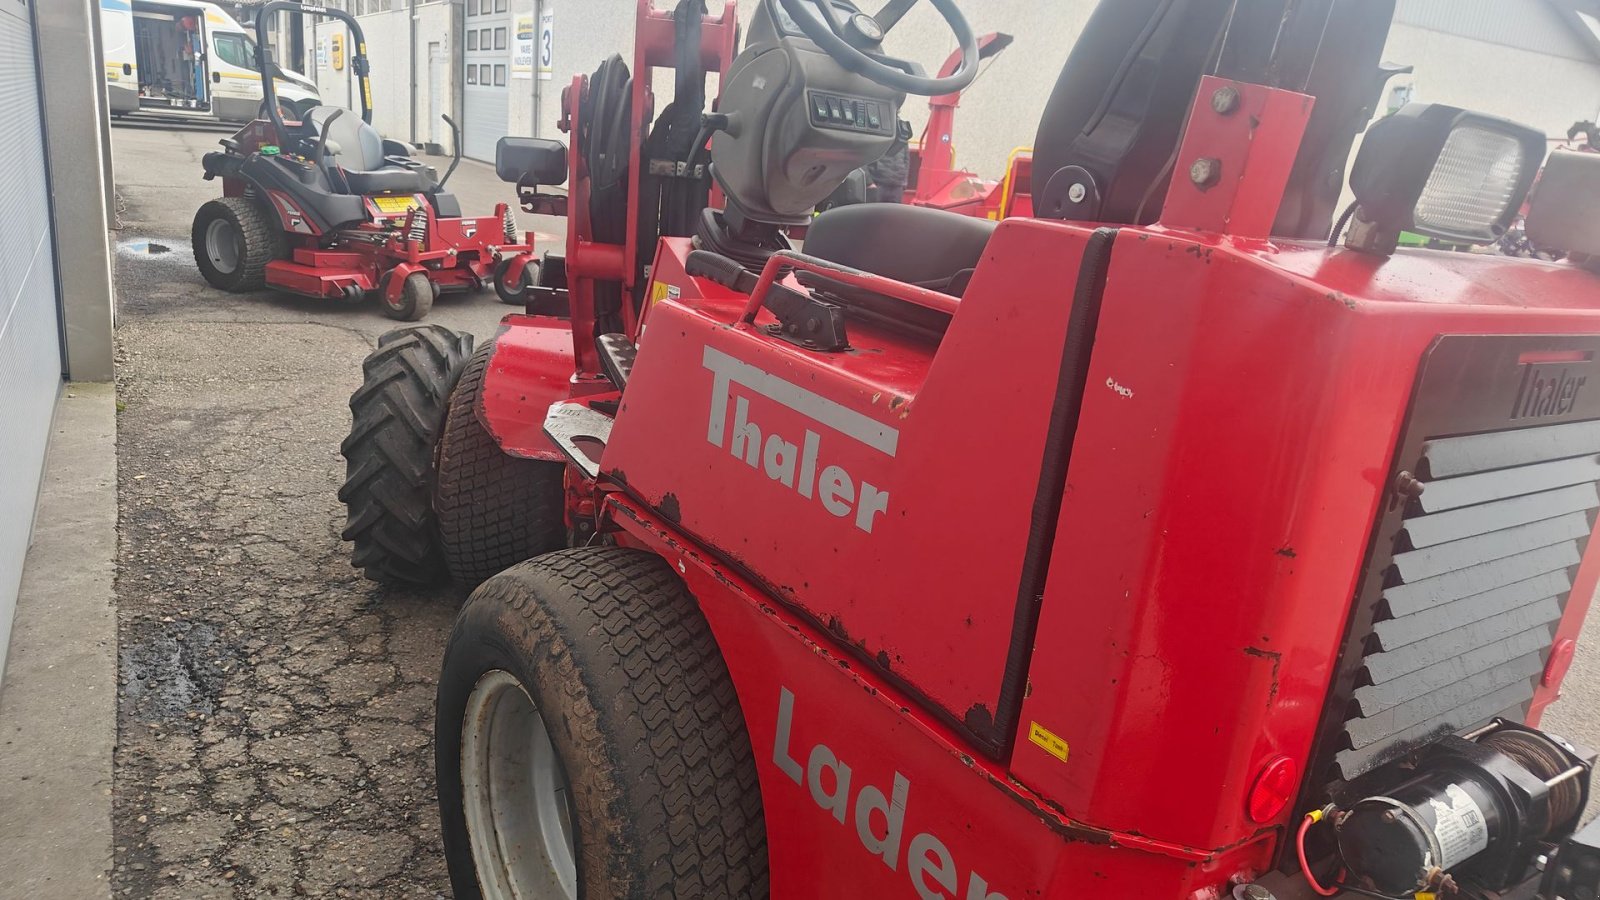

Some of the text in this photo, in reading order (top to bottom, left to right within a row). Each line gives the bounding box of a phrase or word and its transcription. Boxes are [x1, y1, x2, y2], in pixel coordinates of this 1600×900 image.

[542, 15, 553, 23] PORT
[542, 29, 551, 67] 3
[1510, 351, 1592, 420] Thaler
[702, 344, 900, 534] Thaler
